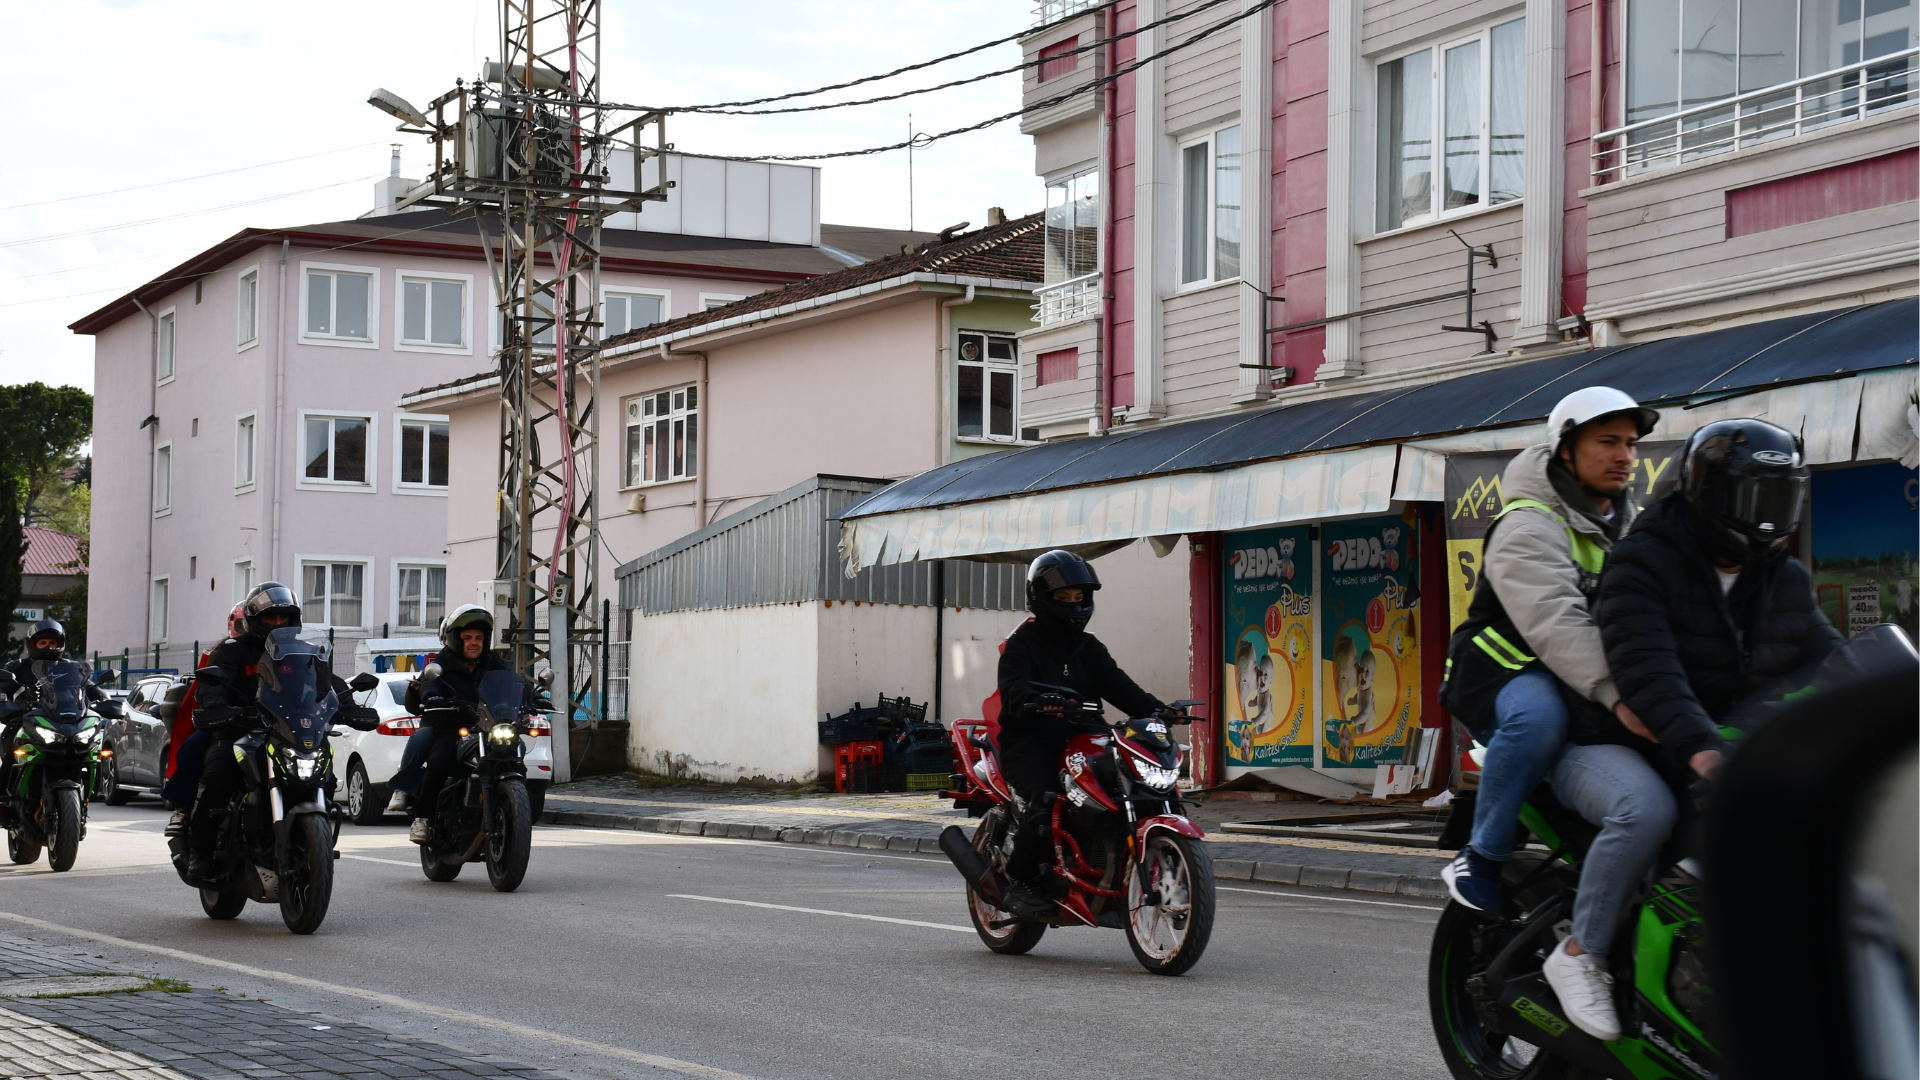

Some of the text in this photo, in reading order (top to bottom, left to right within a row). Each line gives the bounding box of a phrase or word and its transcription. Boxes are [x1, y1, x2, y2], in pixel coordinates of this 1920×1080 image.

[1234, 547, 1279, 580] PEDO
[1333, 537, 1382, 571] PEDO
[1280, 583, 1311, 618] Plus
[1850, 616, 1879, 624] KASAP
[1145, 722, 1168, 734] 46
[1254, 739, 1280, 760] Kalitesi
[1280, 703, 1304, 750] Sevgiden
[1355, 740, 1383, 760] Kalitesi
[1384, 702, 1410, 751] Sevgiden
